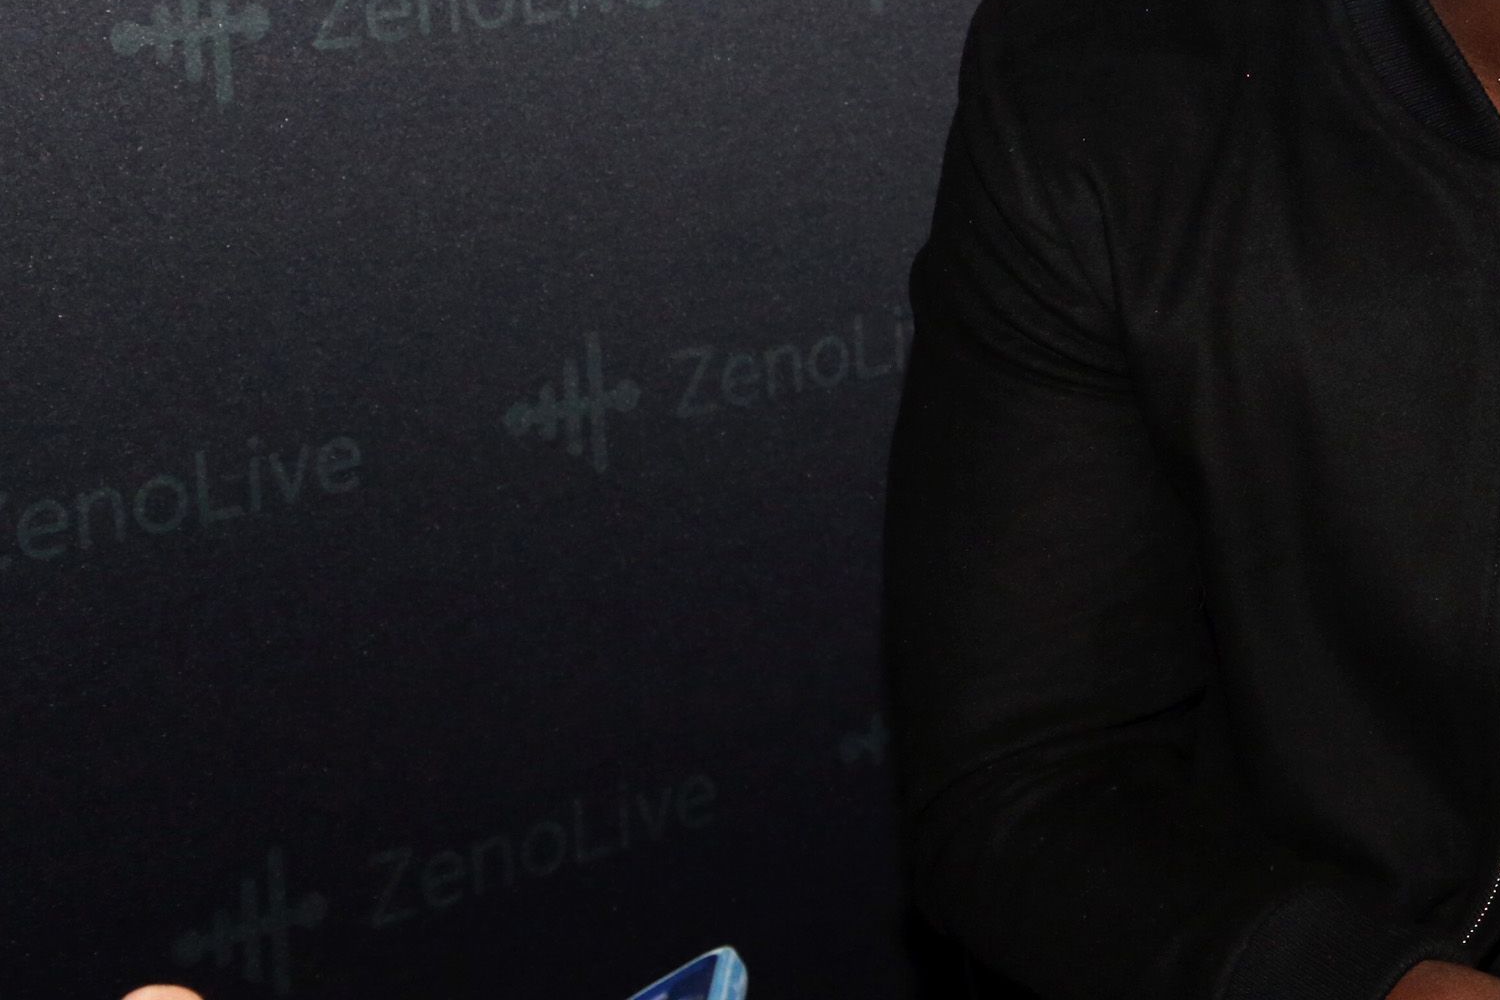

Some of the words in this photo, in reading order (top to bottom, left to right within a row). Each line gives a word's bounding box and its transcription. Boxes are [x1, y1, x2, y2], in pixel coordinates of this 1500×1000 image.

[672, 305, 912, 419] ZenoLi
[0, 436, 363, 571] enoLive
[368, 773, 717, 929] ZenoLive
